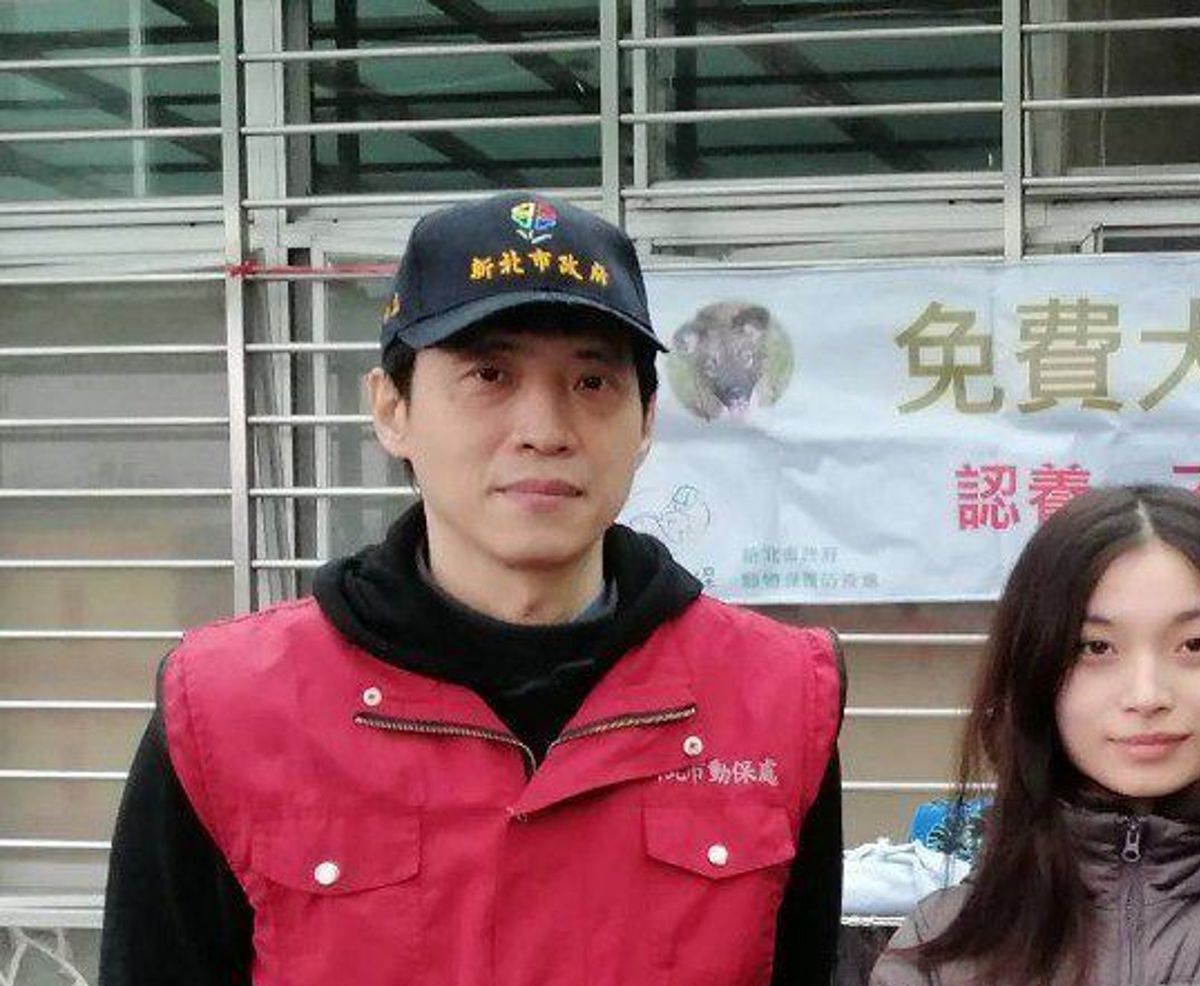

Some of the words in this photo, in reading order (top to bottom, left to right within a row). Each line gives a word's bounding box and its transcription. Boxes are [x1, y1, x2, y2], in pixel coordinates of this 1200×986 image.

[470, 248, 609, 287] 新北市政府
